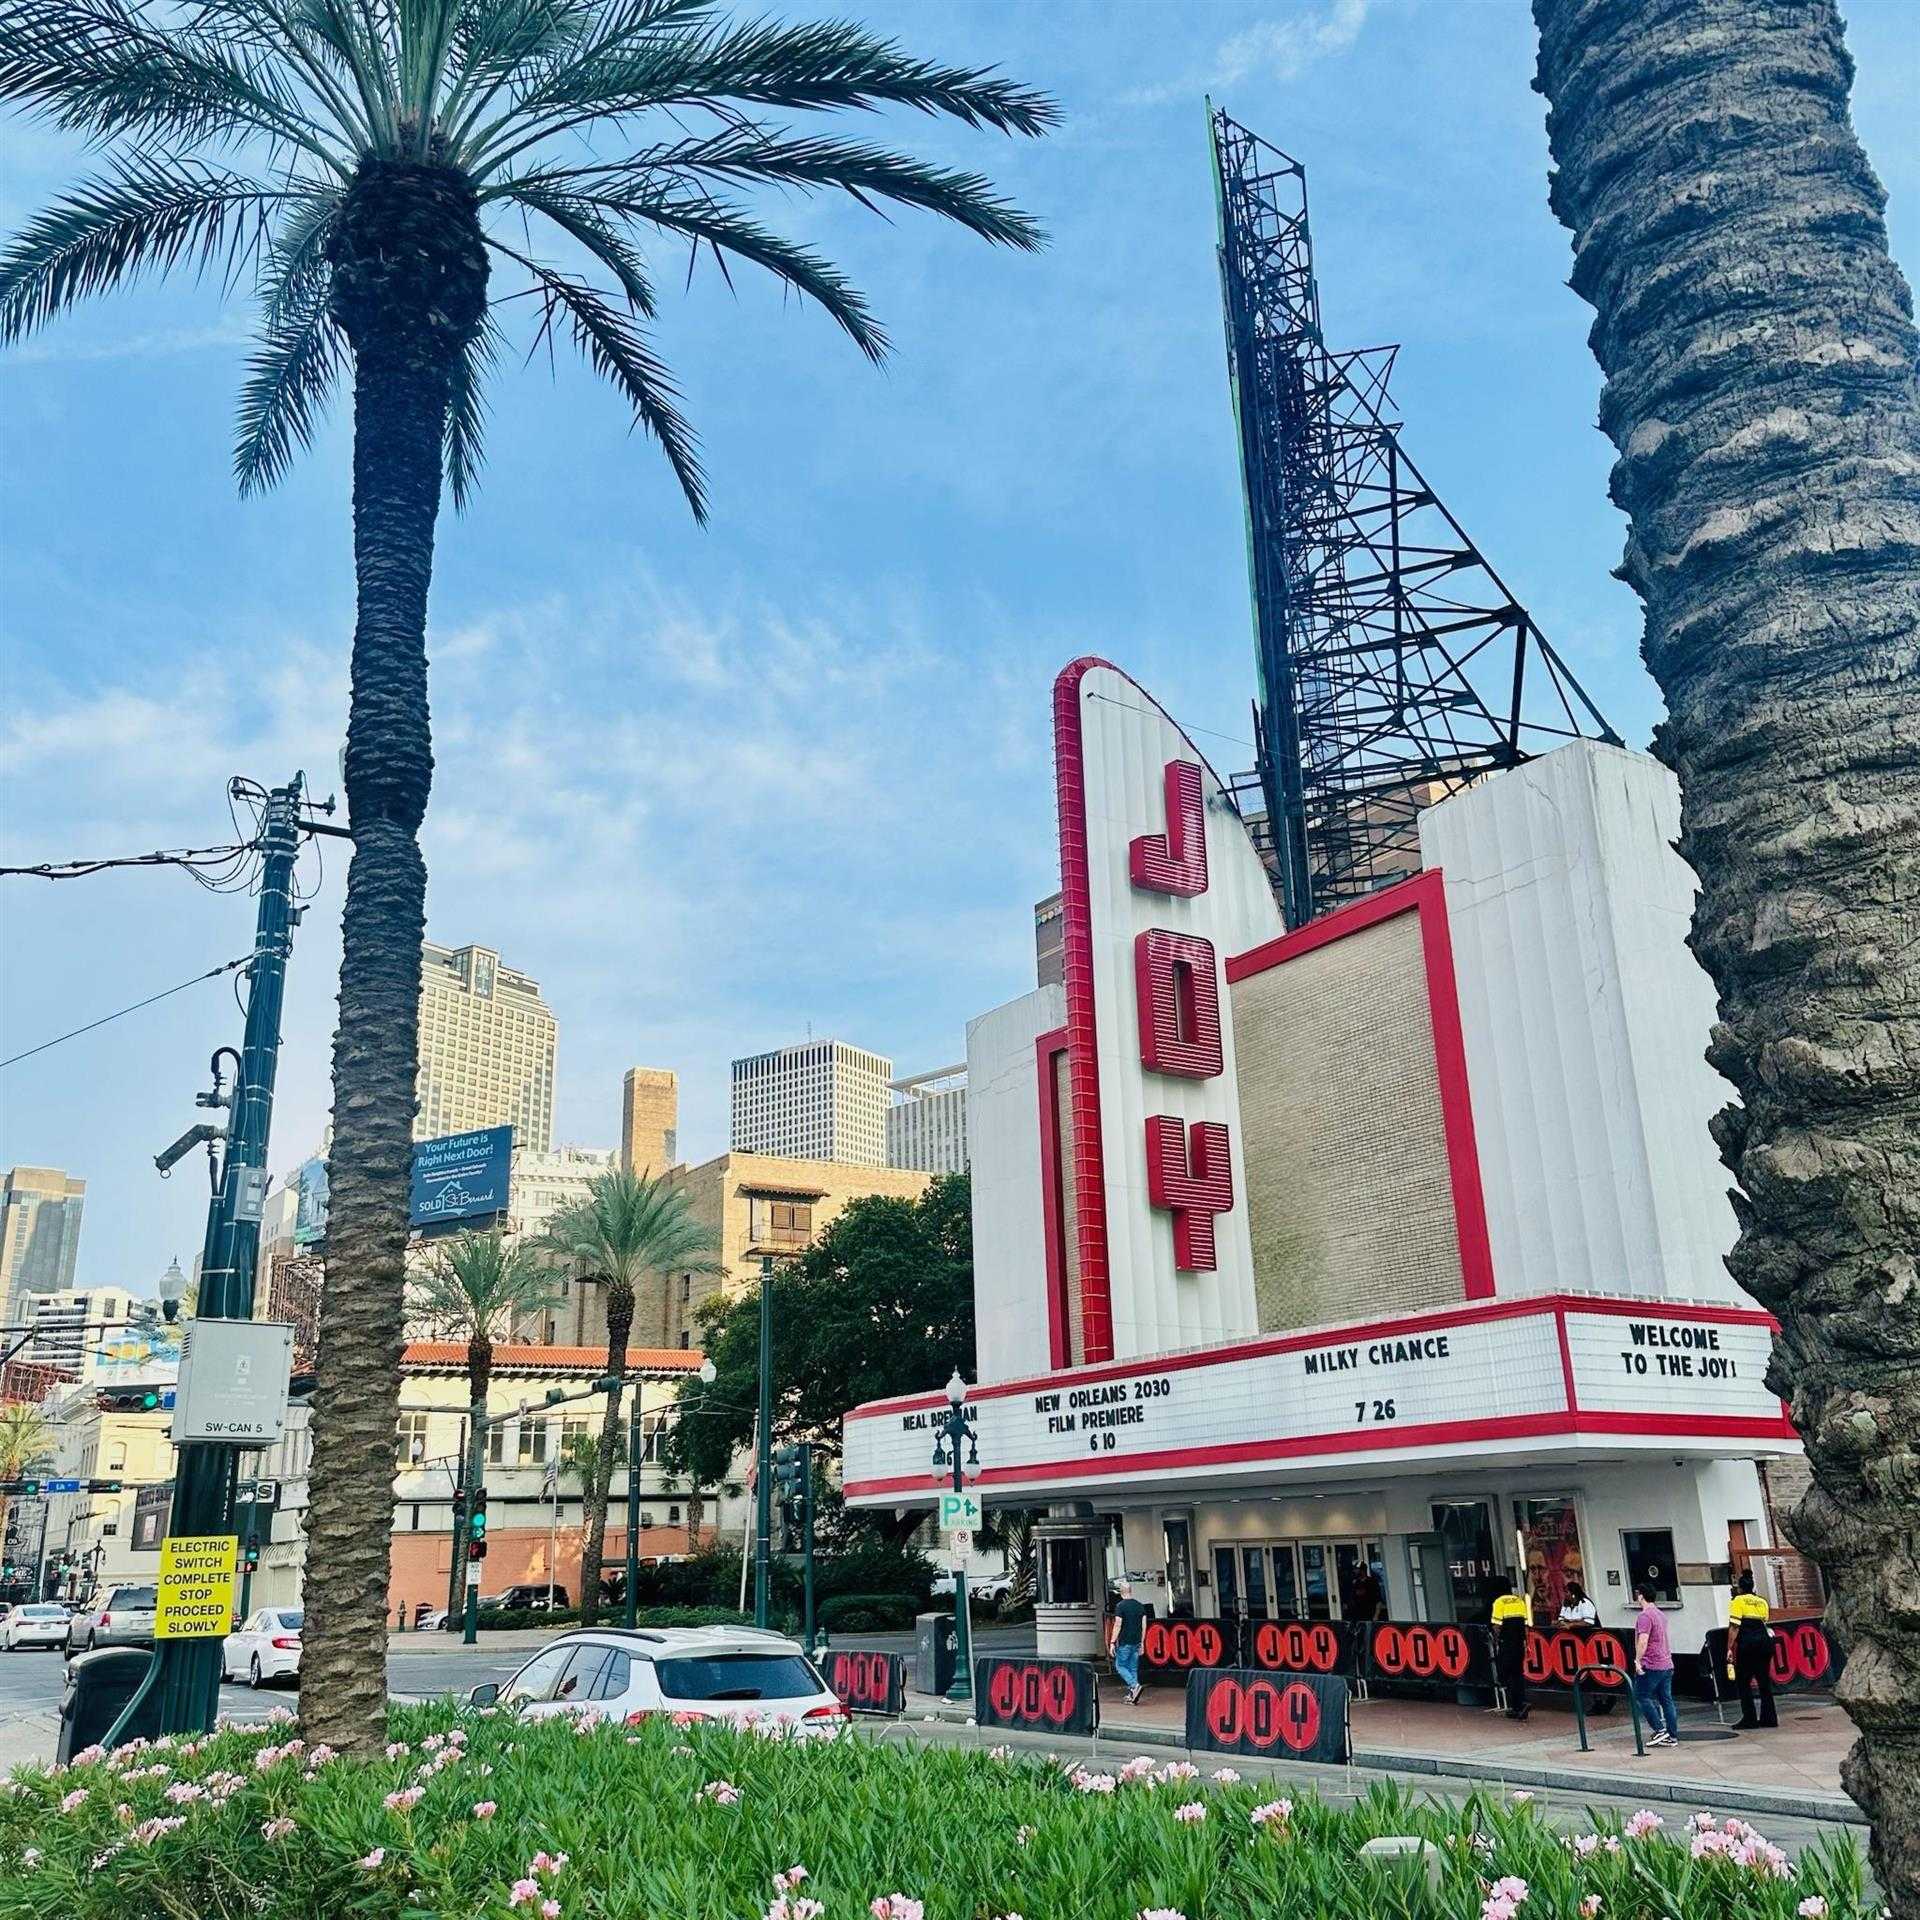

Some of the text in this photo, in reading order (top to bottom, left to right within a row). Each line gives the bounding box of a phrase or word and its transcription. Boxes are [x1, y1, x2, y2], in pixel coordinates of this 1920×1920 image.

[1129, 759, 1233, 1273] JOY
[418, 1145, 494, 1167] Right Next Door!
[425, 1133, 488, 1153] Your Future is
[419, 1200, 441, 1212] SOLD
[1629, 1323, 1720, 1350] WELCOME
[1304, 1336, 1450, 1374] MILKY CHANCE
[1621, 1352, 1737, 1378] TO THE JOY!
[1035, 1378, 1170, 1413] NEW ORLEANS 2030
[902, 1405, 978, 1431] NEAL BREAN
[1049, 1405, 1144, 1433] FILM PREMIERE
[1355, 1399, 1396, 1422] 7 26
[205, 1422, 263, 1433] SW-CAN 5
[1090, 1432, 1116, 1450] 6 10
[171, 1541, 230, 1553] ELECTRIC
[175, 1557, 222, 1569] SWITCH
[164, 1572, 231, 1585] COMPLETE
[180, 1589, 212, 1600] STOP
[165, 1604, 224, 1617] PROCEED
[168, 1620, 218, 1633] SLOWLY
[1153, 1629, 1213, 1661] JOY
[1268, 1629, 1329, 1660] JOY
[1386, 1632, 1459, 1669] JOY
[1527, 1634, 1616, 1677] JOY
[1000, 1672, 1066, 1714] JOY
[1219, 1688, 1308, 1741] JOY
